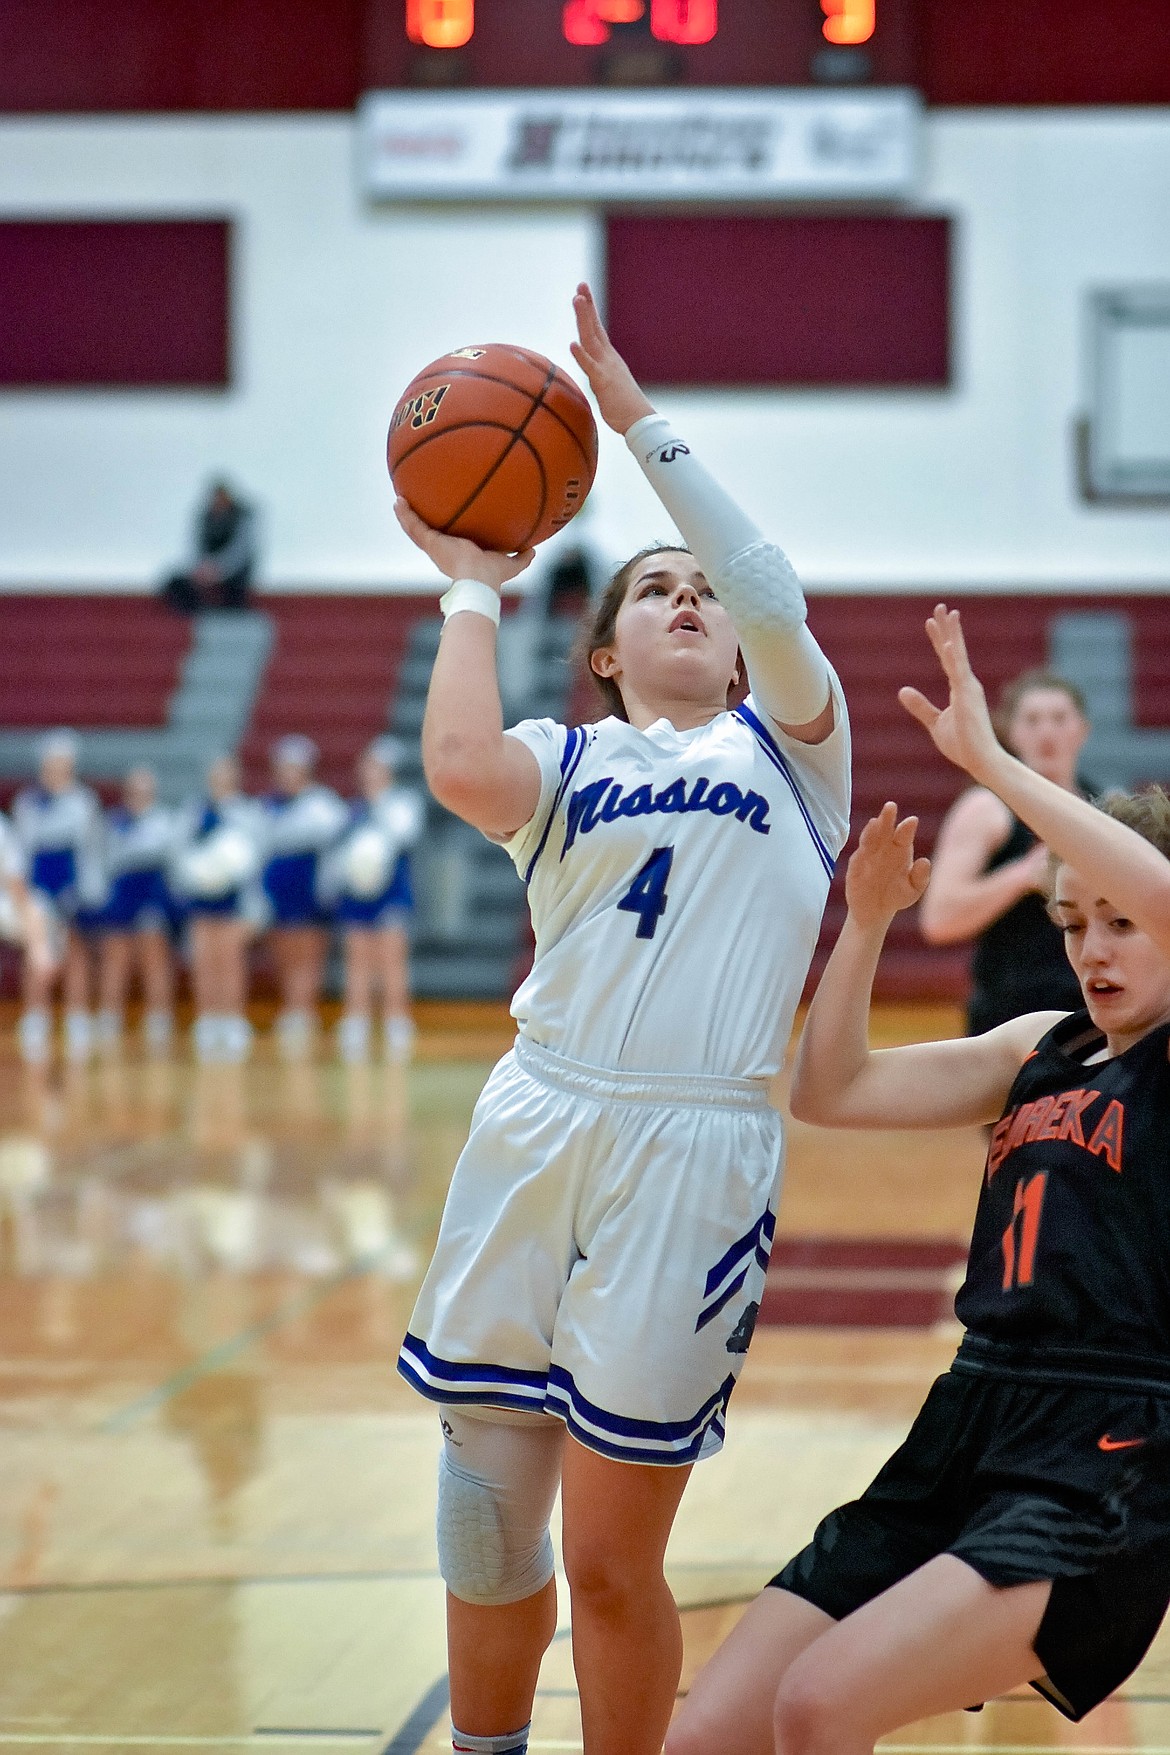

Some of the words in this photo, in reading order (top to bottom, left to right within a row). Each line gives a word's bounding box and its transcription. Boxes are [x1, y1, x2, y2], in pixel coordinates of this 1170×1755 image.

[560, 777, 770, 863] Mission
[617, 845, 674, 939] 4
[1002, 1171, 1046, 1291] 11
